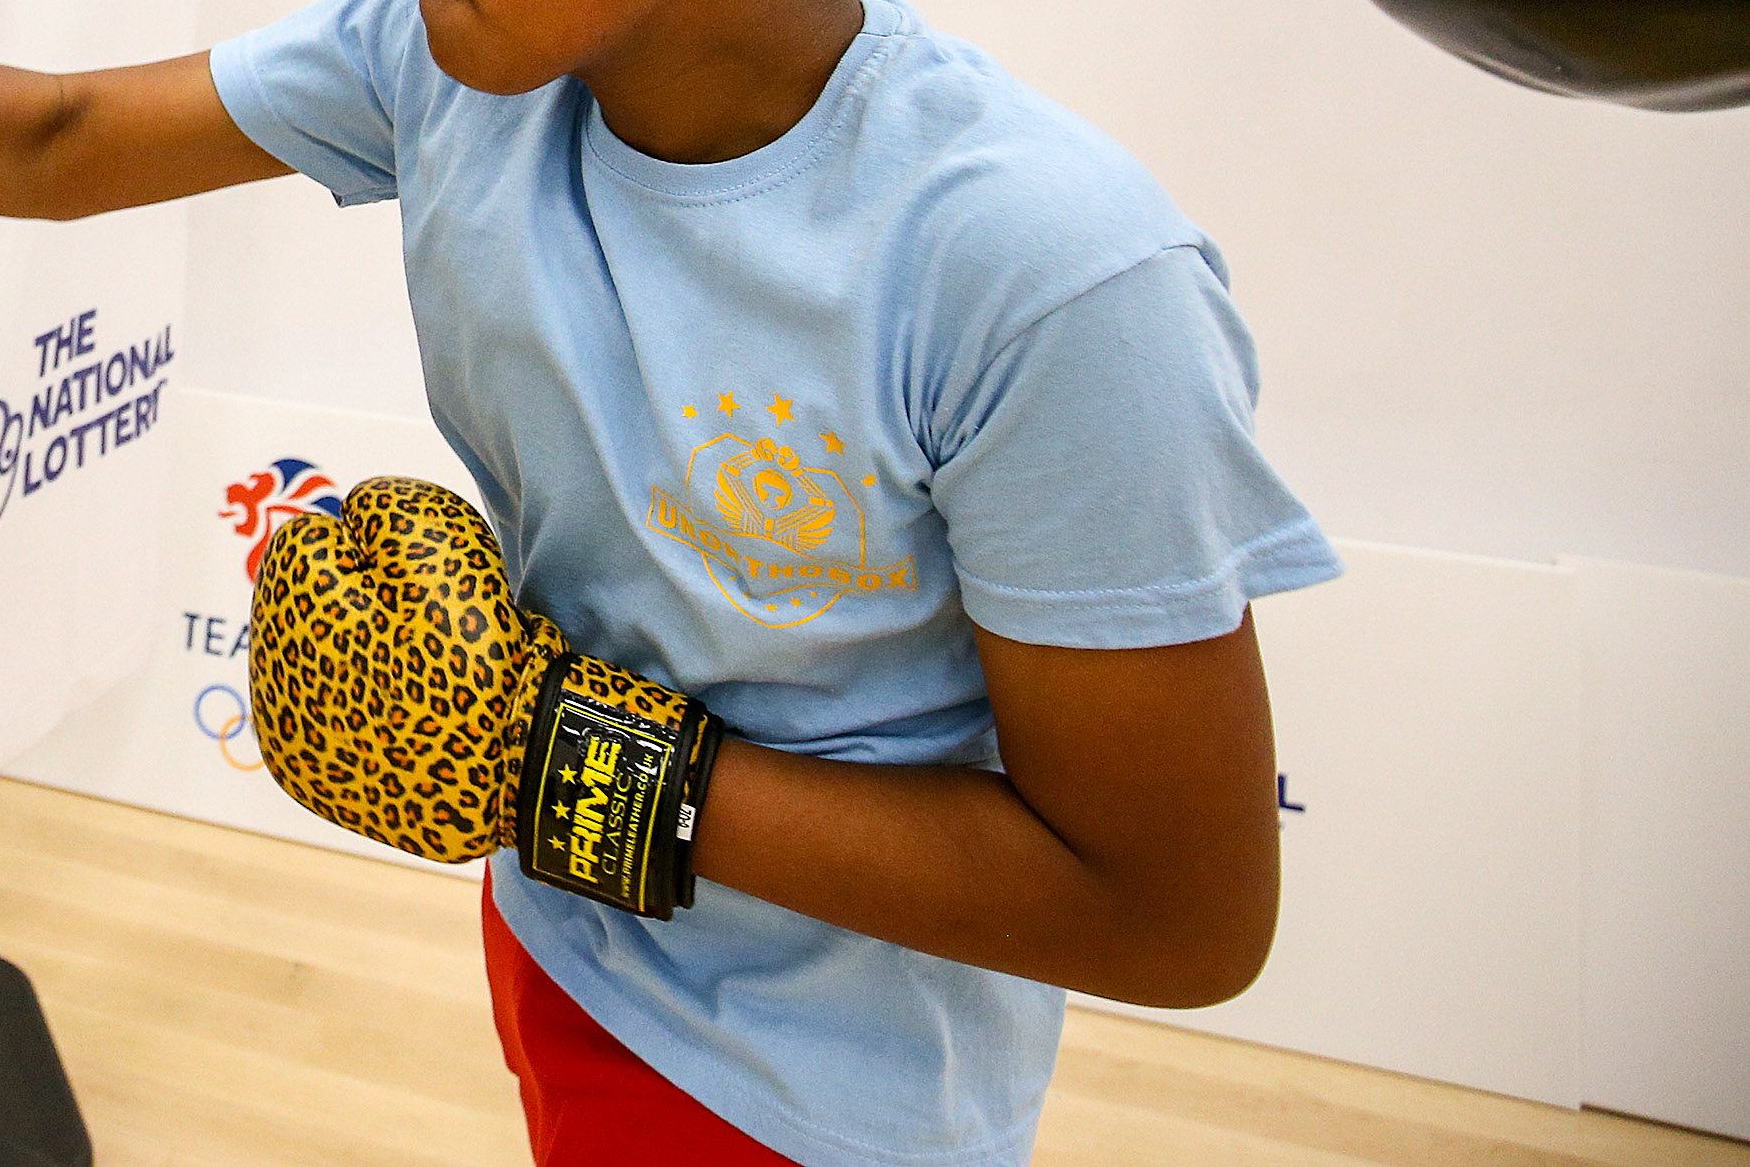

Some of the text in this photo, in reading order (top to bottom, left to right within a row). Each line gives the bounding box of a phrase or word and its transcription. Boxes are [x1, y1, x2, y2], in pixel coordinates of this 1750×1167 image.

[28, 325, 174, 438] NATIONAL
[35, 308, 97, 377] THE
[22, 379, 167, 497] LOTTERY
[569, 736, 621, 884] PRIME
[602, 772, 632, 875] CLASSIC
